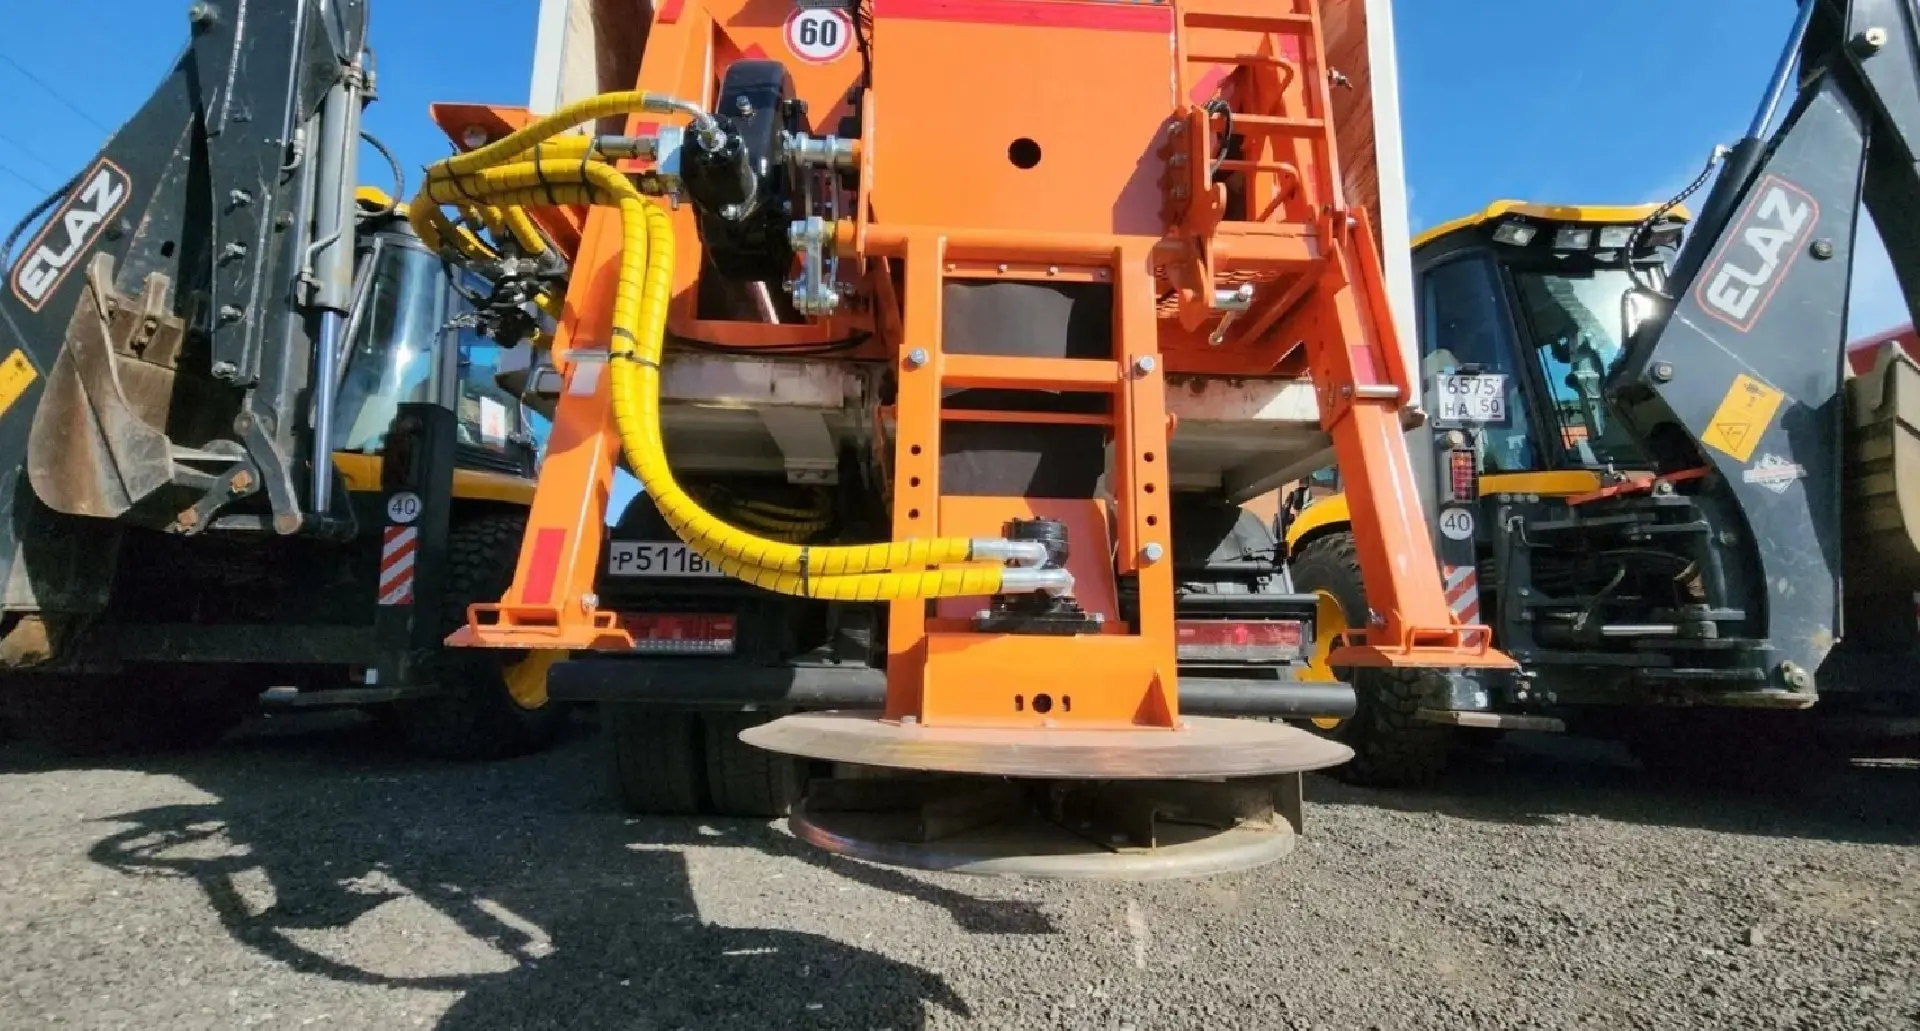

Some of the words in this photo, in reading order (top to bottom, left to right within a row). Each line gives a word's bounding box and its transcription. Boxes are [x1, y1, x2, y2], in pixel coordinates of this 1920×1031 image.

[800, 18, 837, 46] 60
[18, 168, 124, 300] ELAZ
[1706, 186, 1809, 320] ELAZ
[1447, 376, 1496, 395] 6575
[1480, 399, 1499, 413] 50
[391, 498, 416, 515] 40
[1444, 512, 1470, 531] 40
